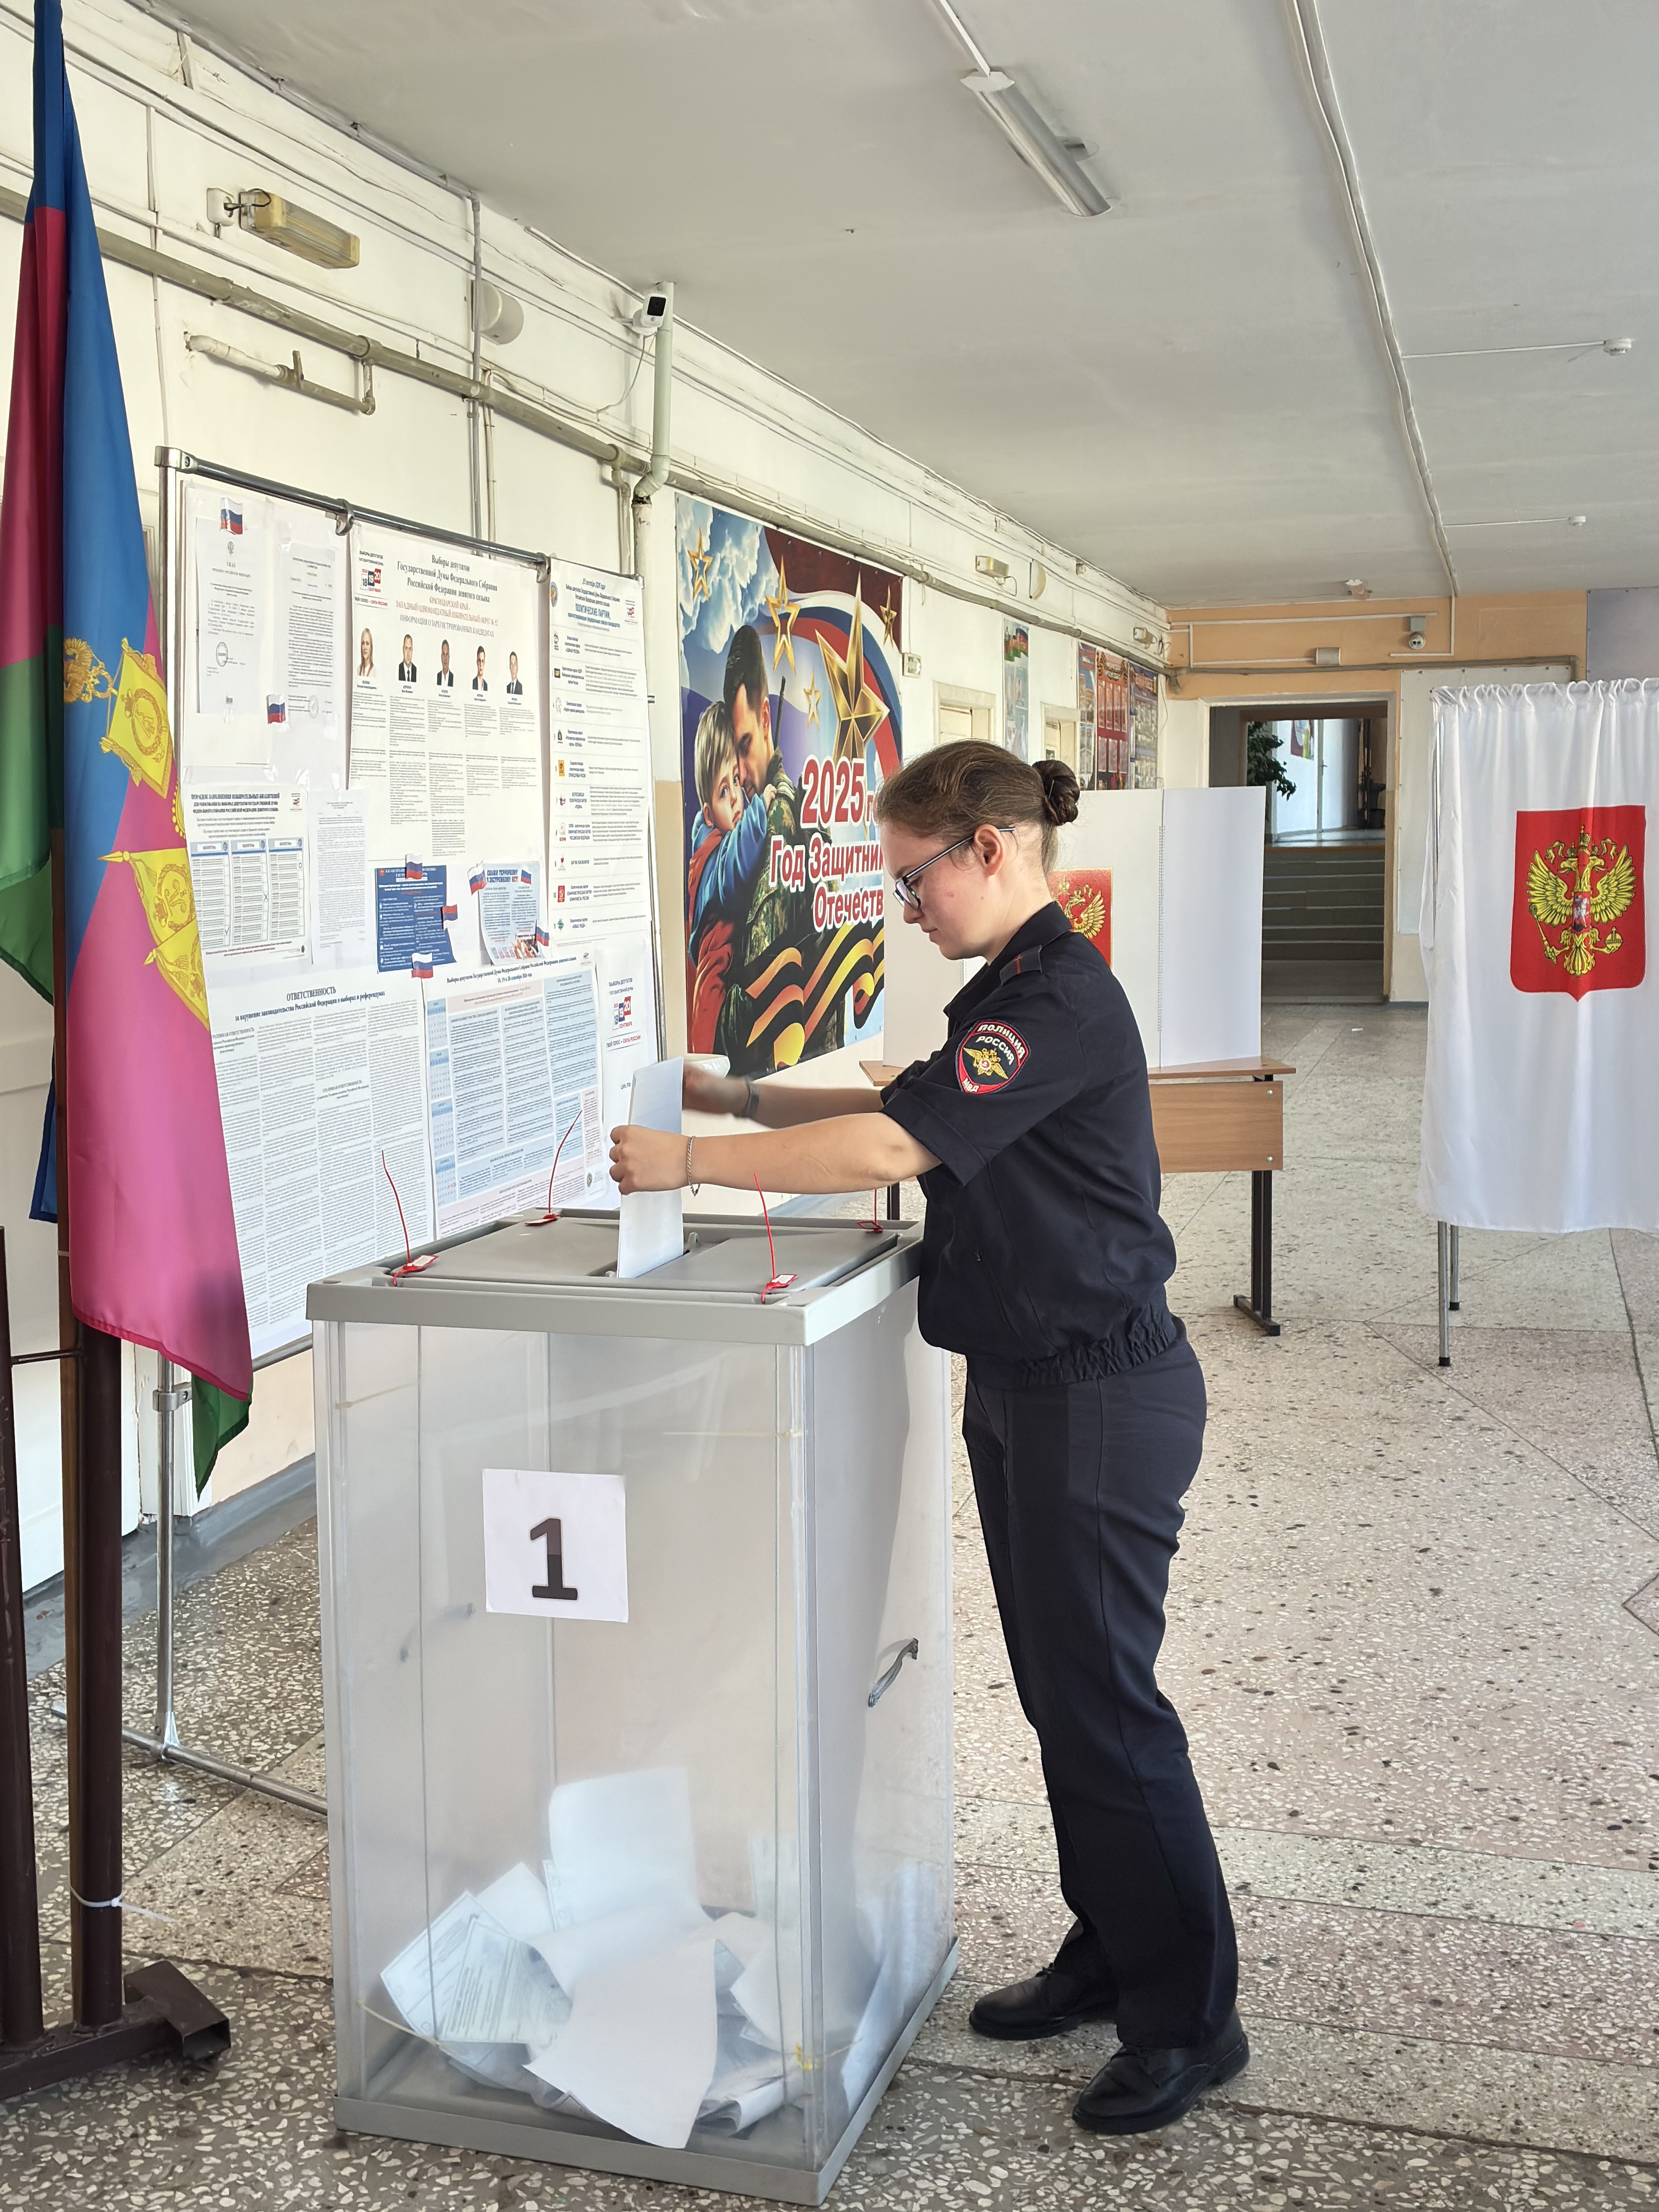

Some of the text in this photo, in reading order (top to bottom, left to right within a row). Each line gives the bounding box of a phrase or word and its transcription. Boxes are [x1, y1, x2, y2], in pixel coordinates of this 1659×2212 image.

[432, 554, 470, 572] Выборы депутатов
[369, 574, 374, 583] 19
[374, 571, 380, 581] 20
[397, 561, 498, 592] Государственной Думы Федерального Собрания
[407, 577, 433, 591] Российской
[434, 583, 457, 596] Федерации
[458, 589, 475, 600] девятого
[396, 600, 418, 611] ЗАПАДНЫЙ
[418, 605, 451, 617] ОДНОМАНДАТНЫЙ
[452, 611, 480, 623] ИЗБИРАТЕЛЬНЫЙ
[429, 596, 459, 609] КРАСНОДАРСКИЙ
[400, 614, 428, 626] ИНФОРМАЦИЯ
[432, 620, 472, 633] ЗАРЕГИСТРИРОВАННЫХ
[473, 626, 495, 637] КАНДИДАТАХ
[801, 756, 865, 826] 2025
[770, 838, 804, 890] Год
[813, 884, 883, 929] Отечеств
[286, 986, 336, 1001] ОТВЕТСТВЕННОСТЬ
[240, 1012, 260, 1022] нарушение
[261, 1005, 294, 1016] законодательства
[295, 1000, 317, 1011] Российской
[317, 997, 337, 1007] Федерации
[340, 995, 357, 1004] выборах
[360, 991, 385, 1002] референдумах
[619, 1006, 624, 1018] 19
[624, 1001, 630, 1012] 20
[614, 1015, 618, 1025] 18
[975, 1036, 1014, 1065] РОССИЯ
[977, 1024, 1025, 1060] ПОЛИЦИЯ
[963, 1077, 979, 1092] МВД
[530, 1518, 578, 1600] 1
